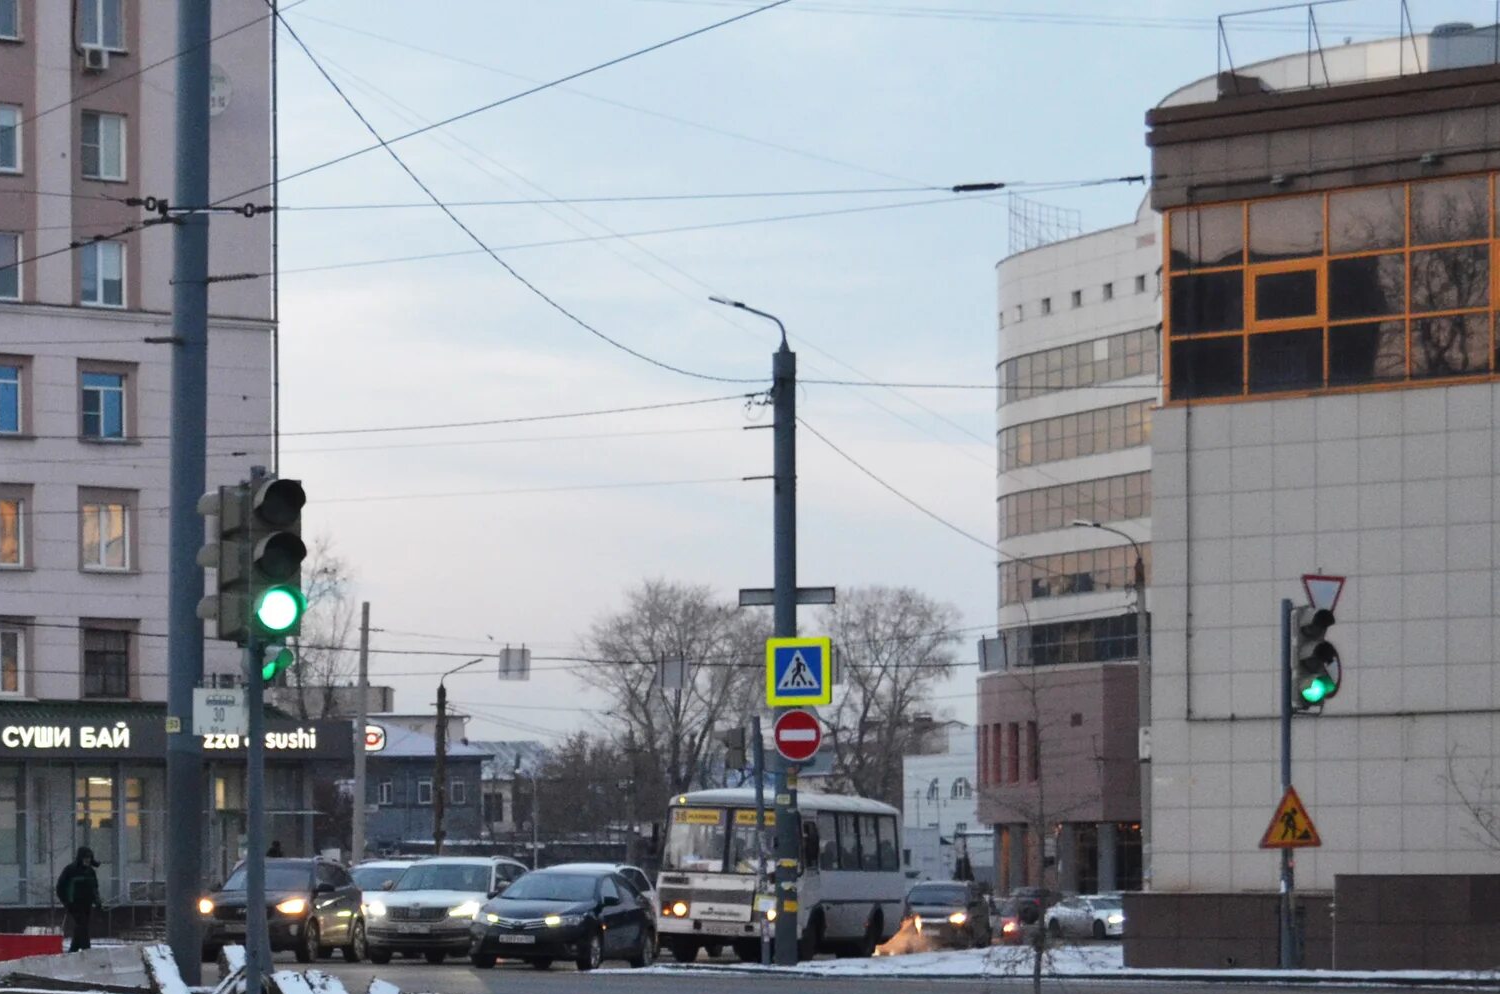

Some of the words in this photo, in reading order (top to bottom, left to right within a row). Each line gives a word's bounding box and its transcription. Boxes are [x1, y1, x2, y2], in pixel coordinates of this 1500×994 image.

[213, 706, 225, 722] 30
[2, 725, 71, 748] СУШИ
[80, 721, 130, 748] БАЙ
[203, 733, 239, 749] zza
[265, 728, 316, 749] sushi
